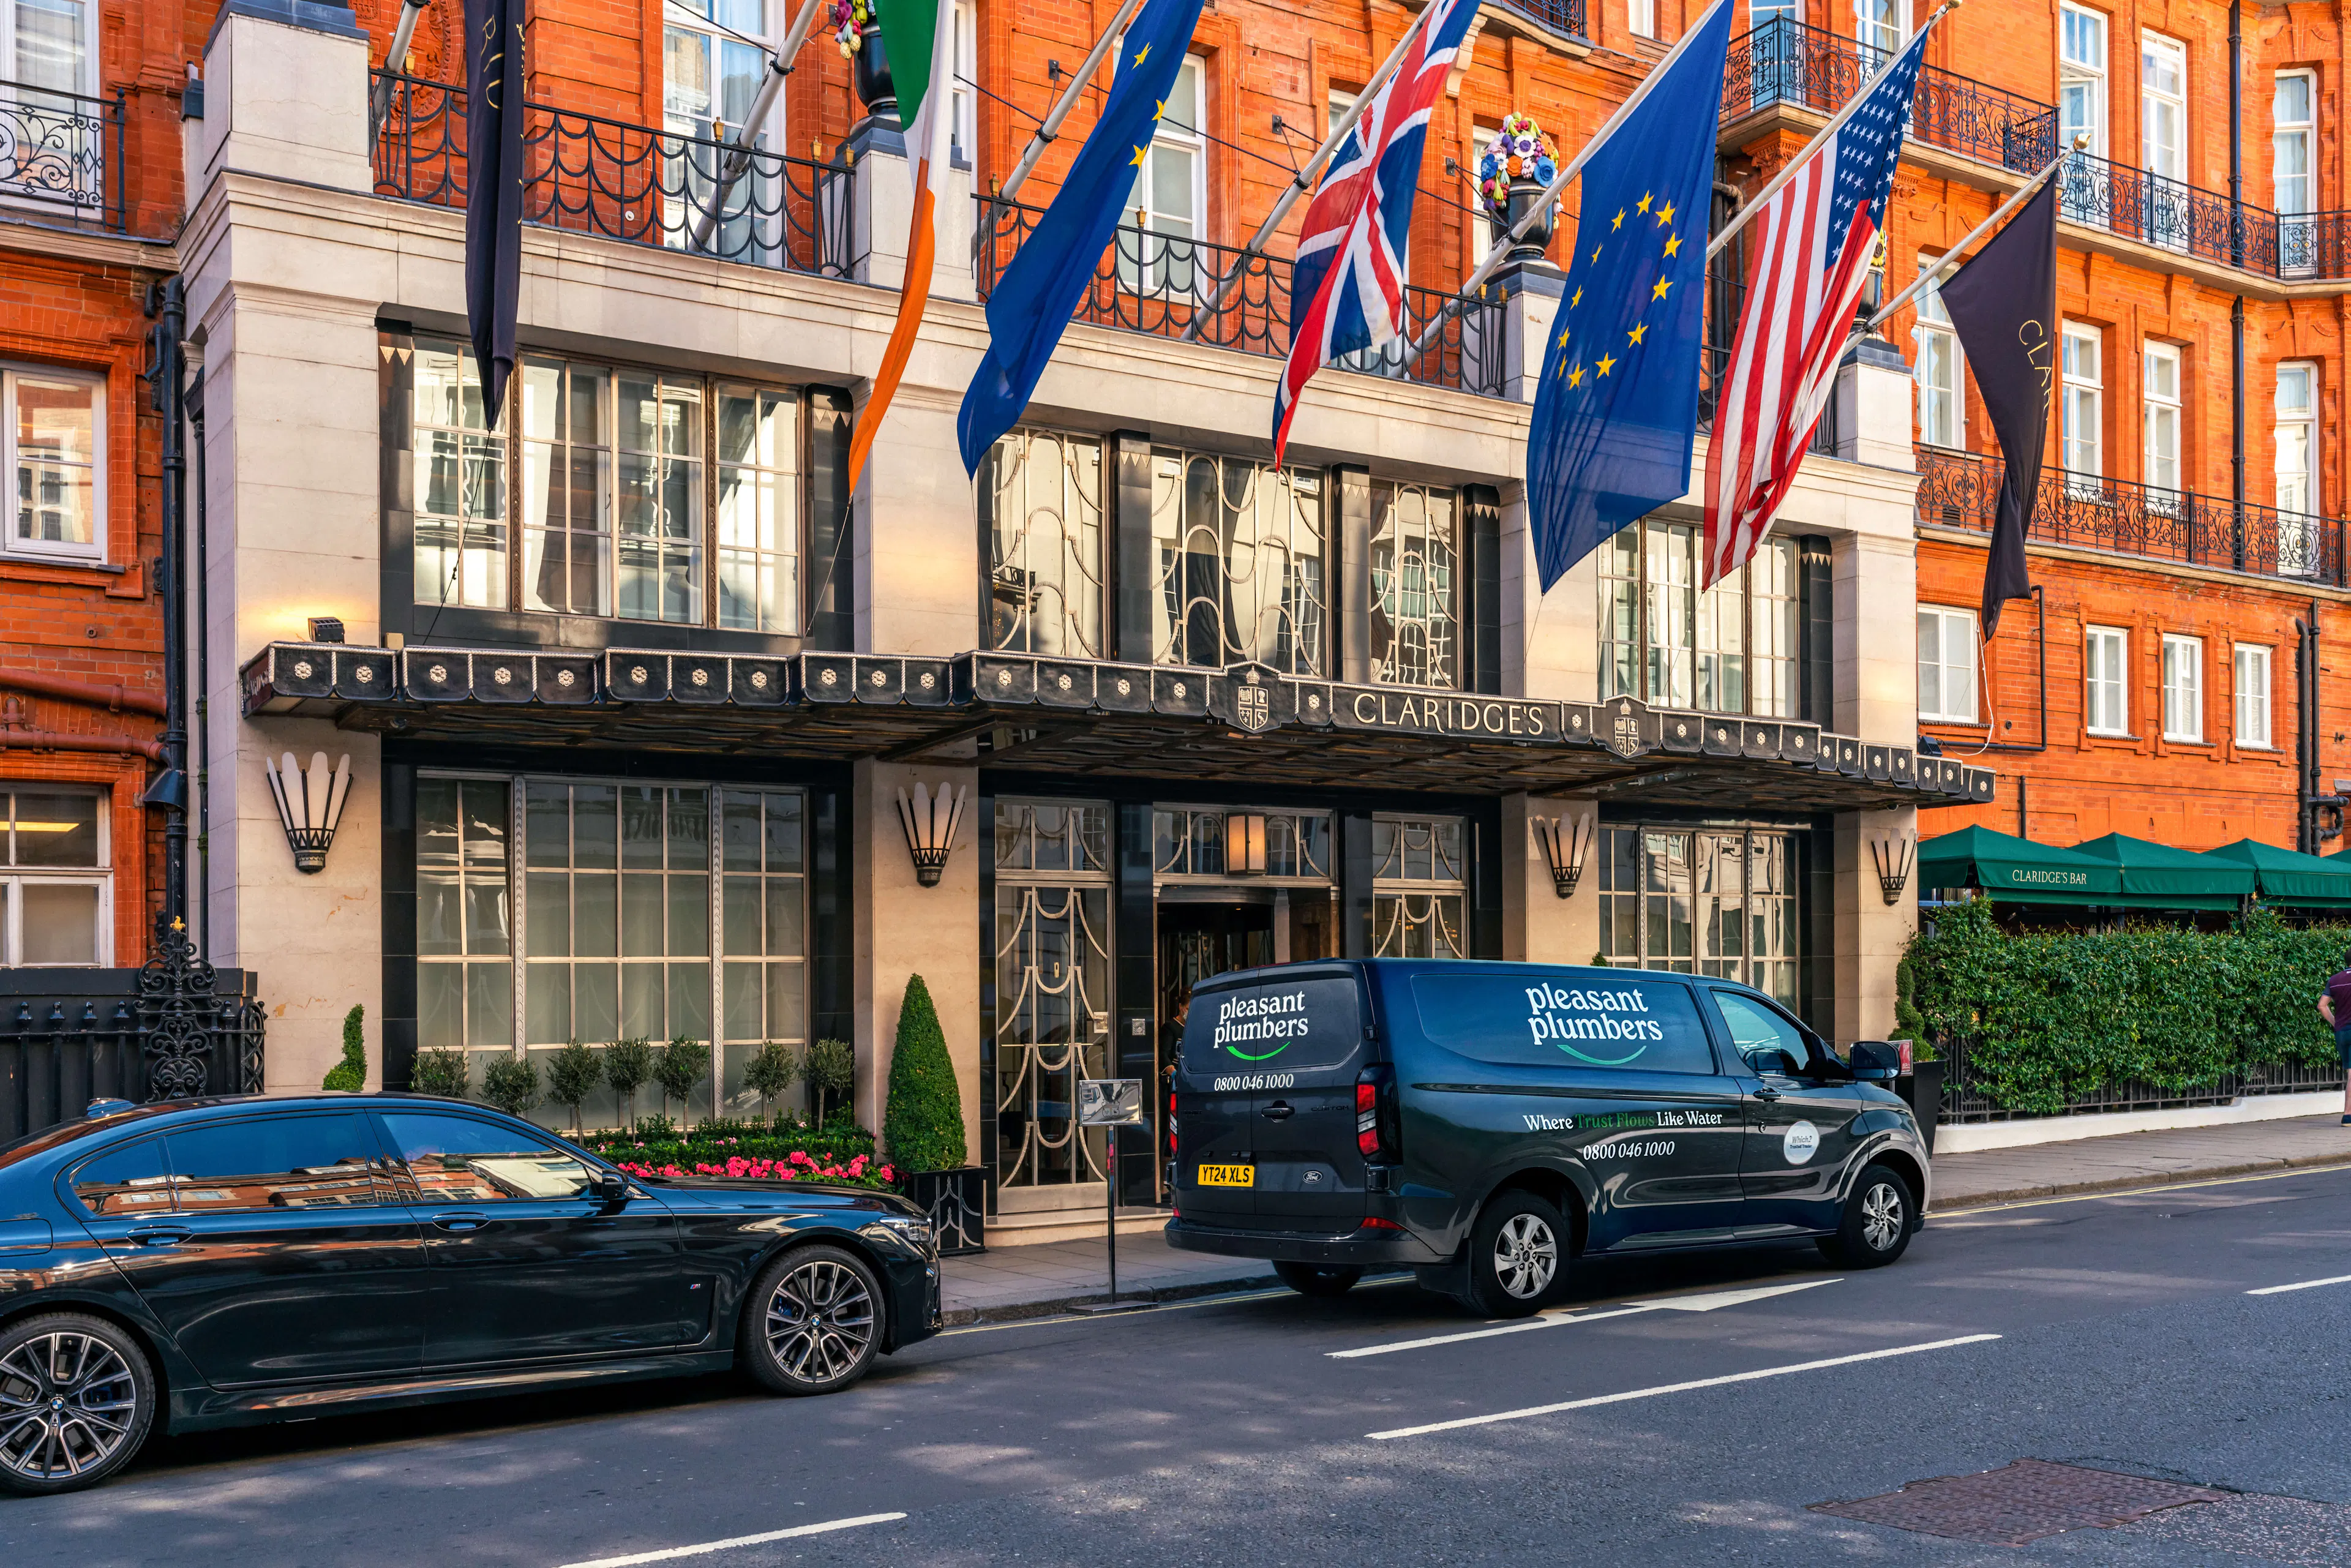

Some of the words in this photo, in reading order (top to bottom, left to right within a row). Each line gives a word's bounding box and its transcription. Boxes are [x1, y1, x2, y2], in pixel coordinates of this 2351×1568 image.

[1353, 693, 1543, 735] CLARIDGE'S
[2012, 869, 2068, 883] CLARIDGE'S
[2070, 872, 2087, 885] BAR
[1219, 991, 1305, 1024] pleasant
[1525, 982, 1649, 1015] pleasant
[1213, 1016, 1308, 1048] plumbers
[1528, 1011, 1663, 1045] plumbers
[1214, 1077, 1240, 1091] 0800
[1242, 1075, 1263, 1089] 046
[1265, 1073, 1294, 1088] 1000
[1523, 1114, 1573, 1130] Where
[1575, 1113, 1613, 1128] Trust
[1616, 1112, 1654, 1127] Flows
[1656, 1111, 1684, 1126] Like
[1685, 1111, 1723, 1125] Water
[1583, 1144, 1616, 1160] 0800
[1618, 1142, 1642, 1158] 046
[1644, 1141, 1675, 1157] 1000
[1203, 1166, 1226, 1182] YT24
[1229, 1167, 1250, 1183] XLS
